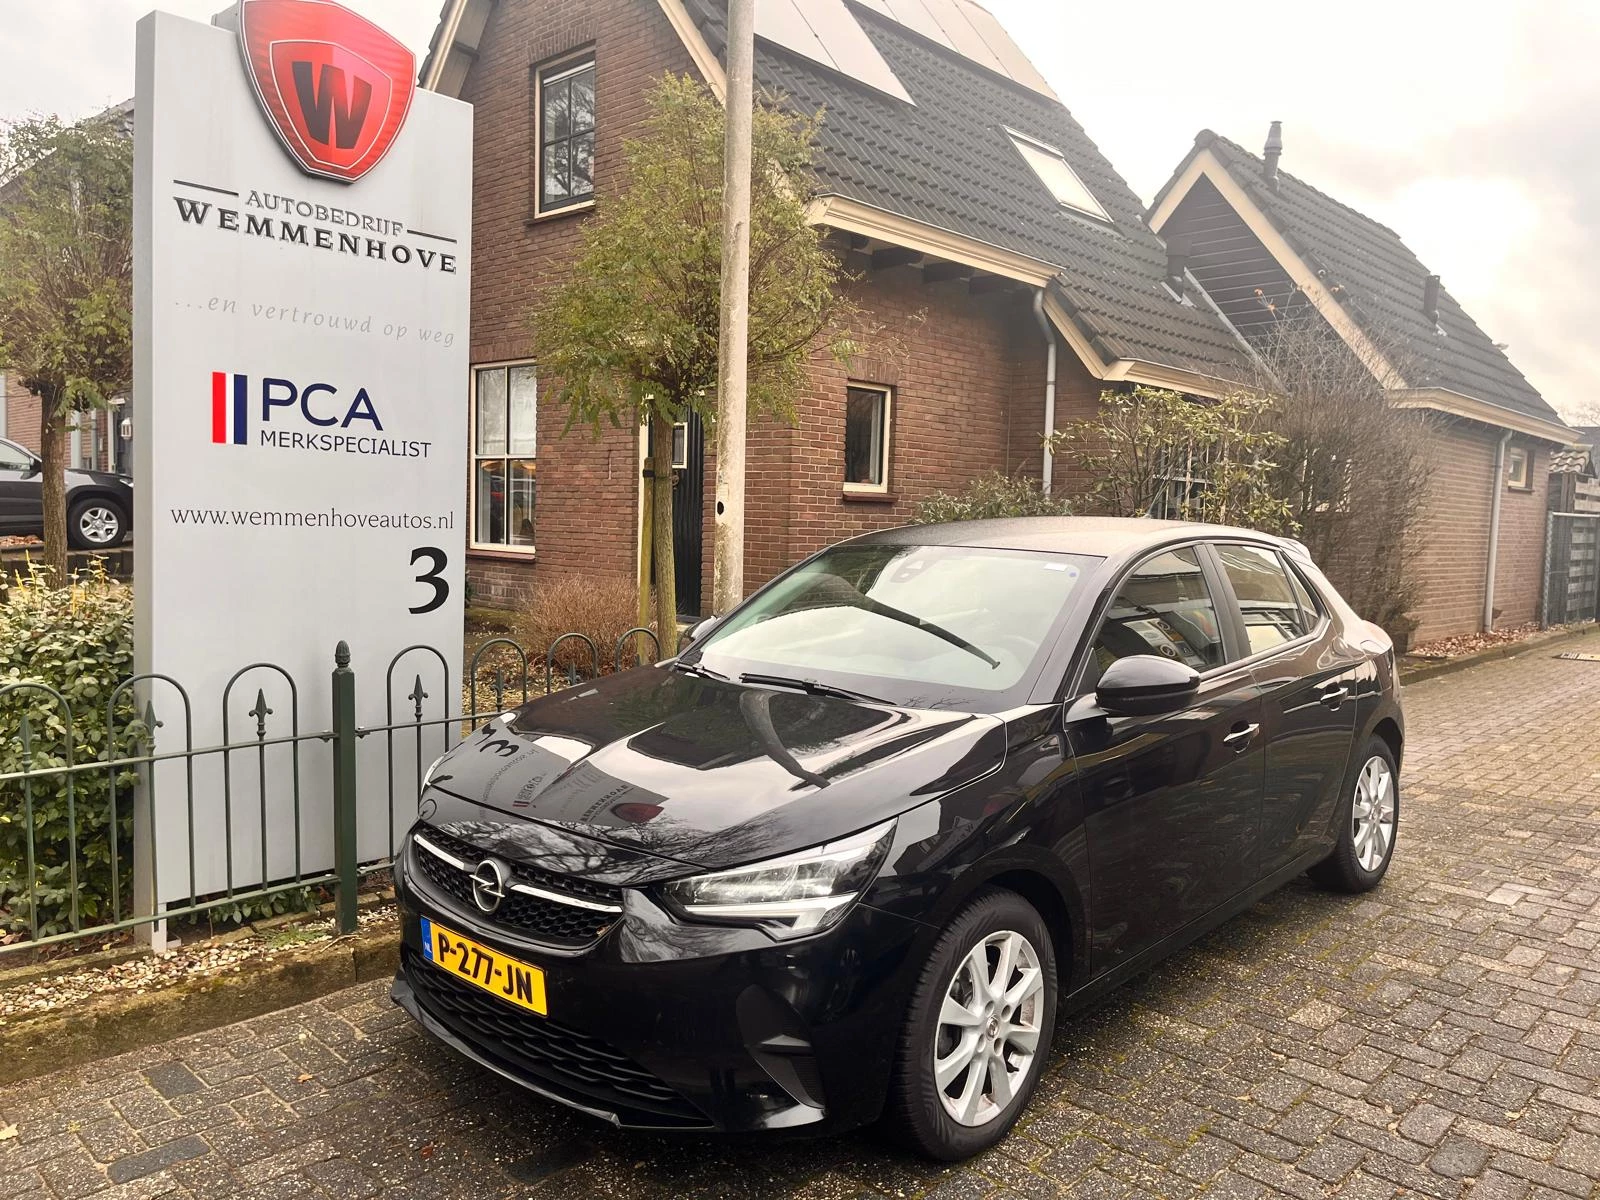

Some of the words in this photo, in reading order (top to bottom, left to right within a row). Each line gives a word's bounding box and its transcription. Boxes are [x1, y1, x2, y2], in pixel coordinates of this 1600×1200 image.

[291, 61, 373, 150] W
[173, 196, 457, 274] WEMMENHOVE
[246, 190, 404, 237] AUTOBEDRIJF
[252, 303, 372, 333] vertrouwd
[383, 323, 408, 341] op
[419, 328, 455, 348] weg
[262, 377, 384, 431] PCA
[260, 430, 432, 458] MERKSPECIALIST
[170, 508, 455, 529] www.wemmenhoveautos.nl
[408, 546, 451, 615] 3
[437, 932, 533, 1004] P-277-JN
